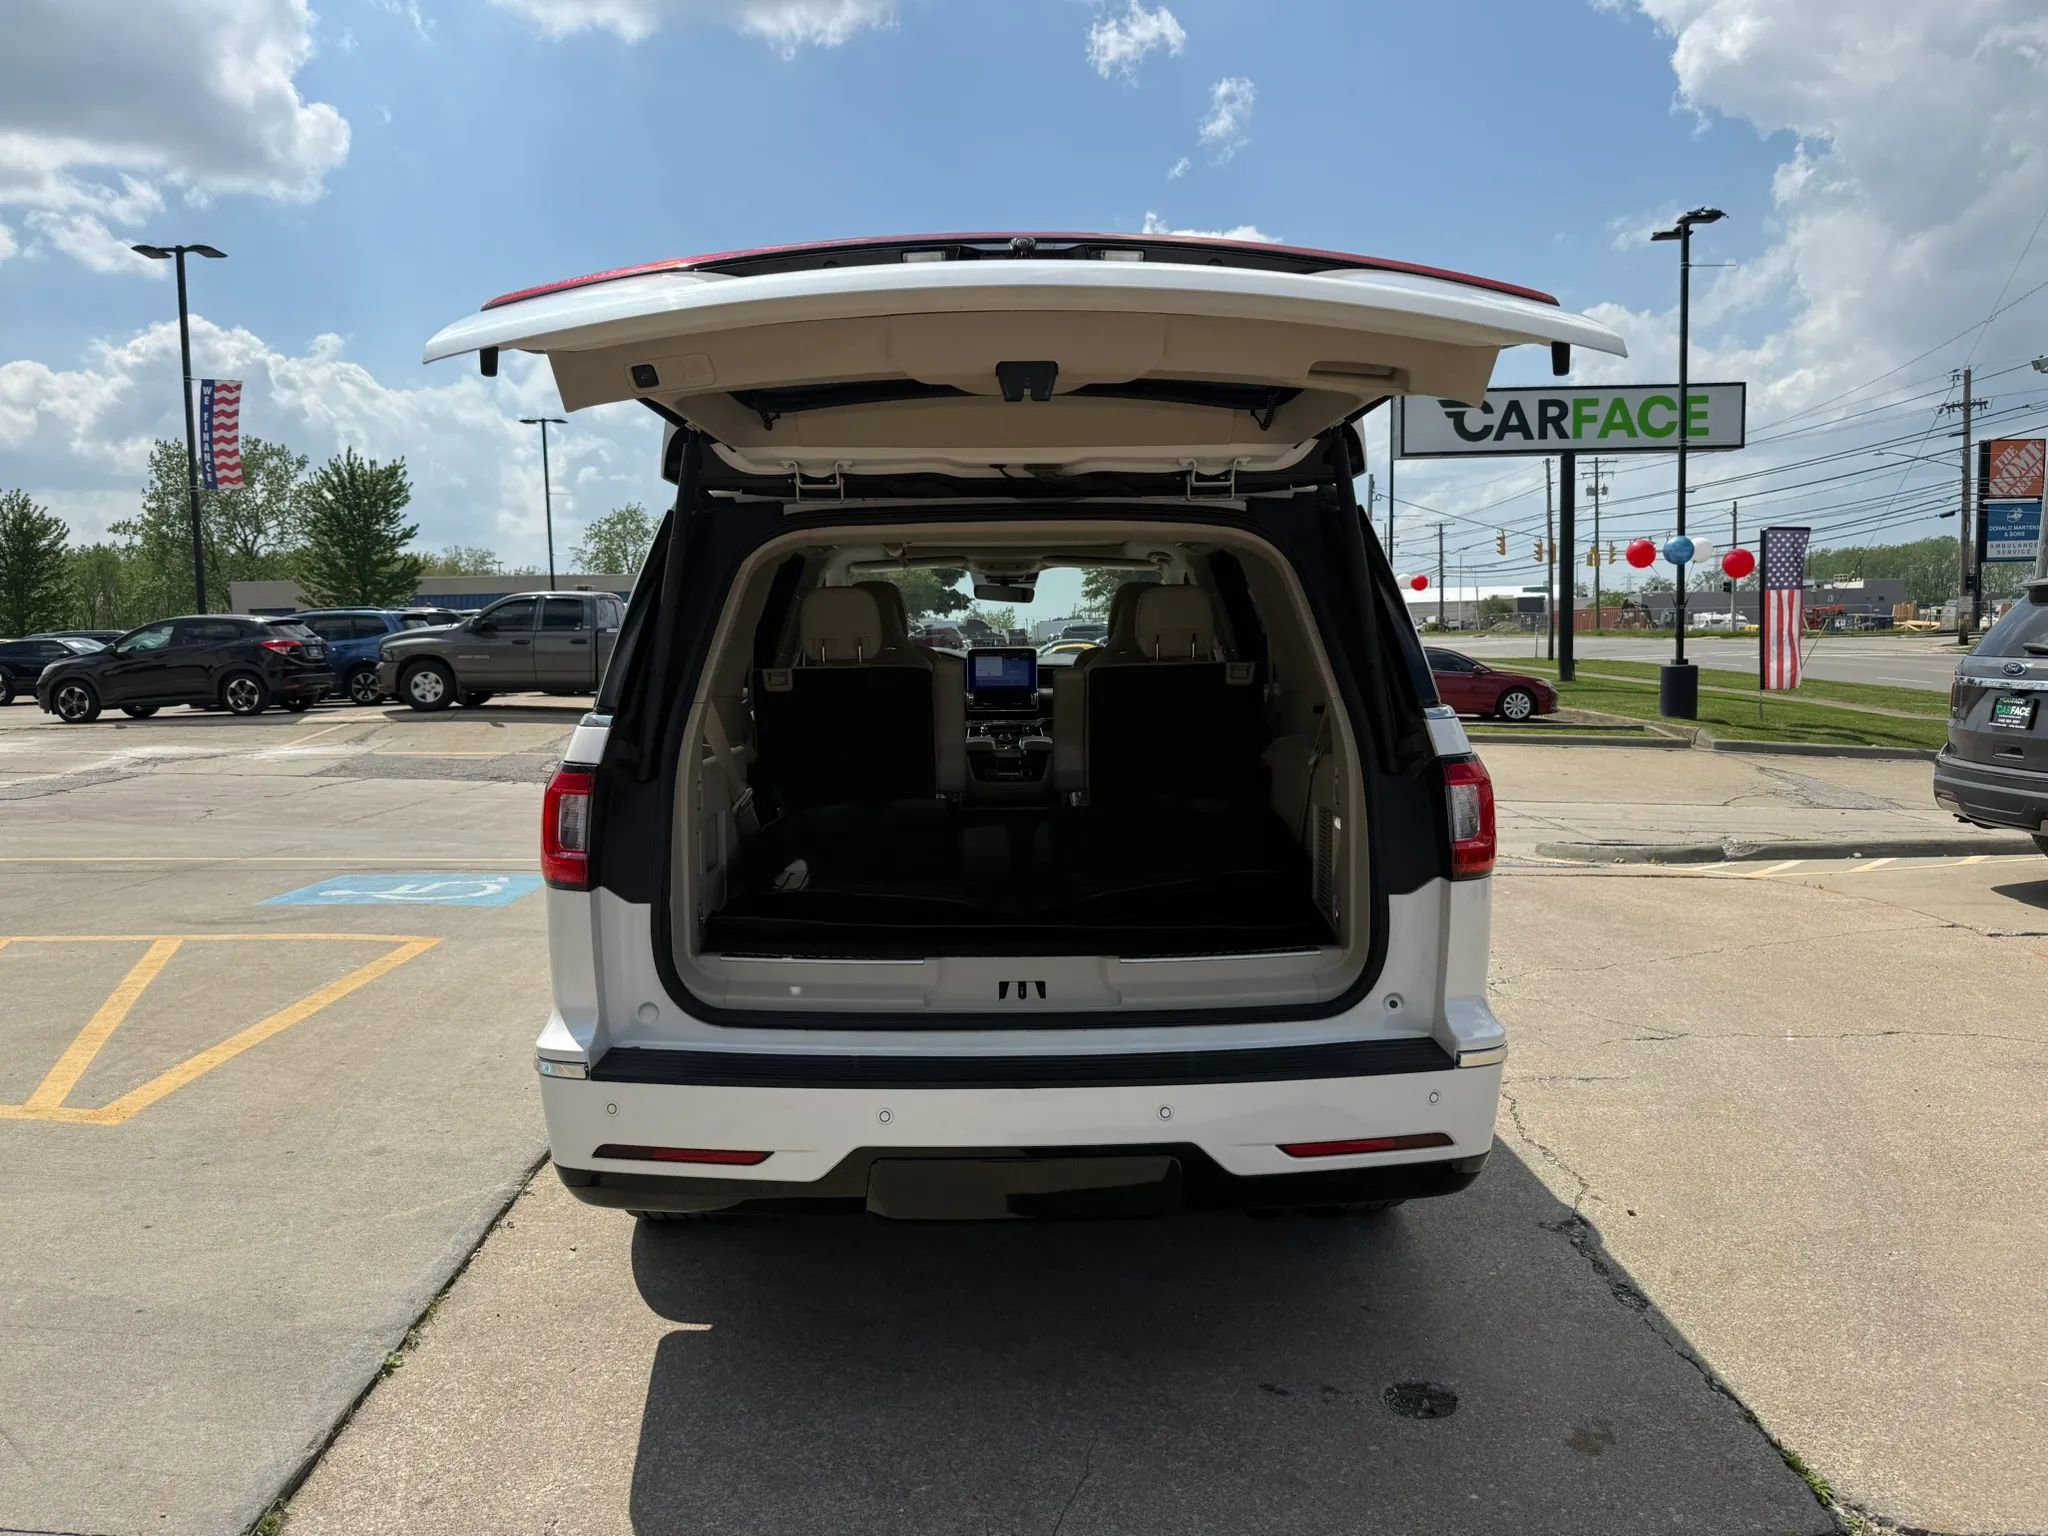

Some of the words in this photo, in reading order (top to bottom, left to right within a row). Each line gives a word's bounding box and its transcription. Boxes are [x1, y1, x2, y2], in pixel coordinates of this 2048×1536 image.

[202, 386, 212, 405] WE
[1438, 395, 1710, 443] CARFACE
[203, 412, 212, 482] FINANCE
[1993, 445, 2018, 469] THE
[1989, 440, 2044, 496] HOME
[1996, 705, 2031, 716] CARFACE
